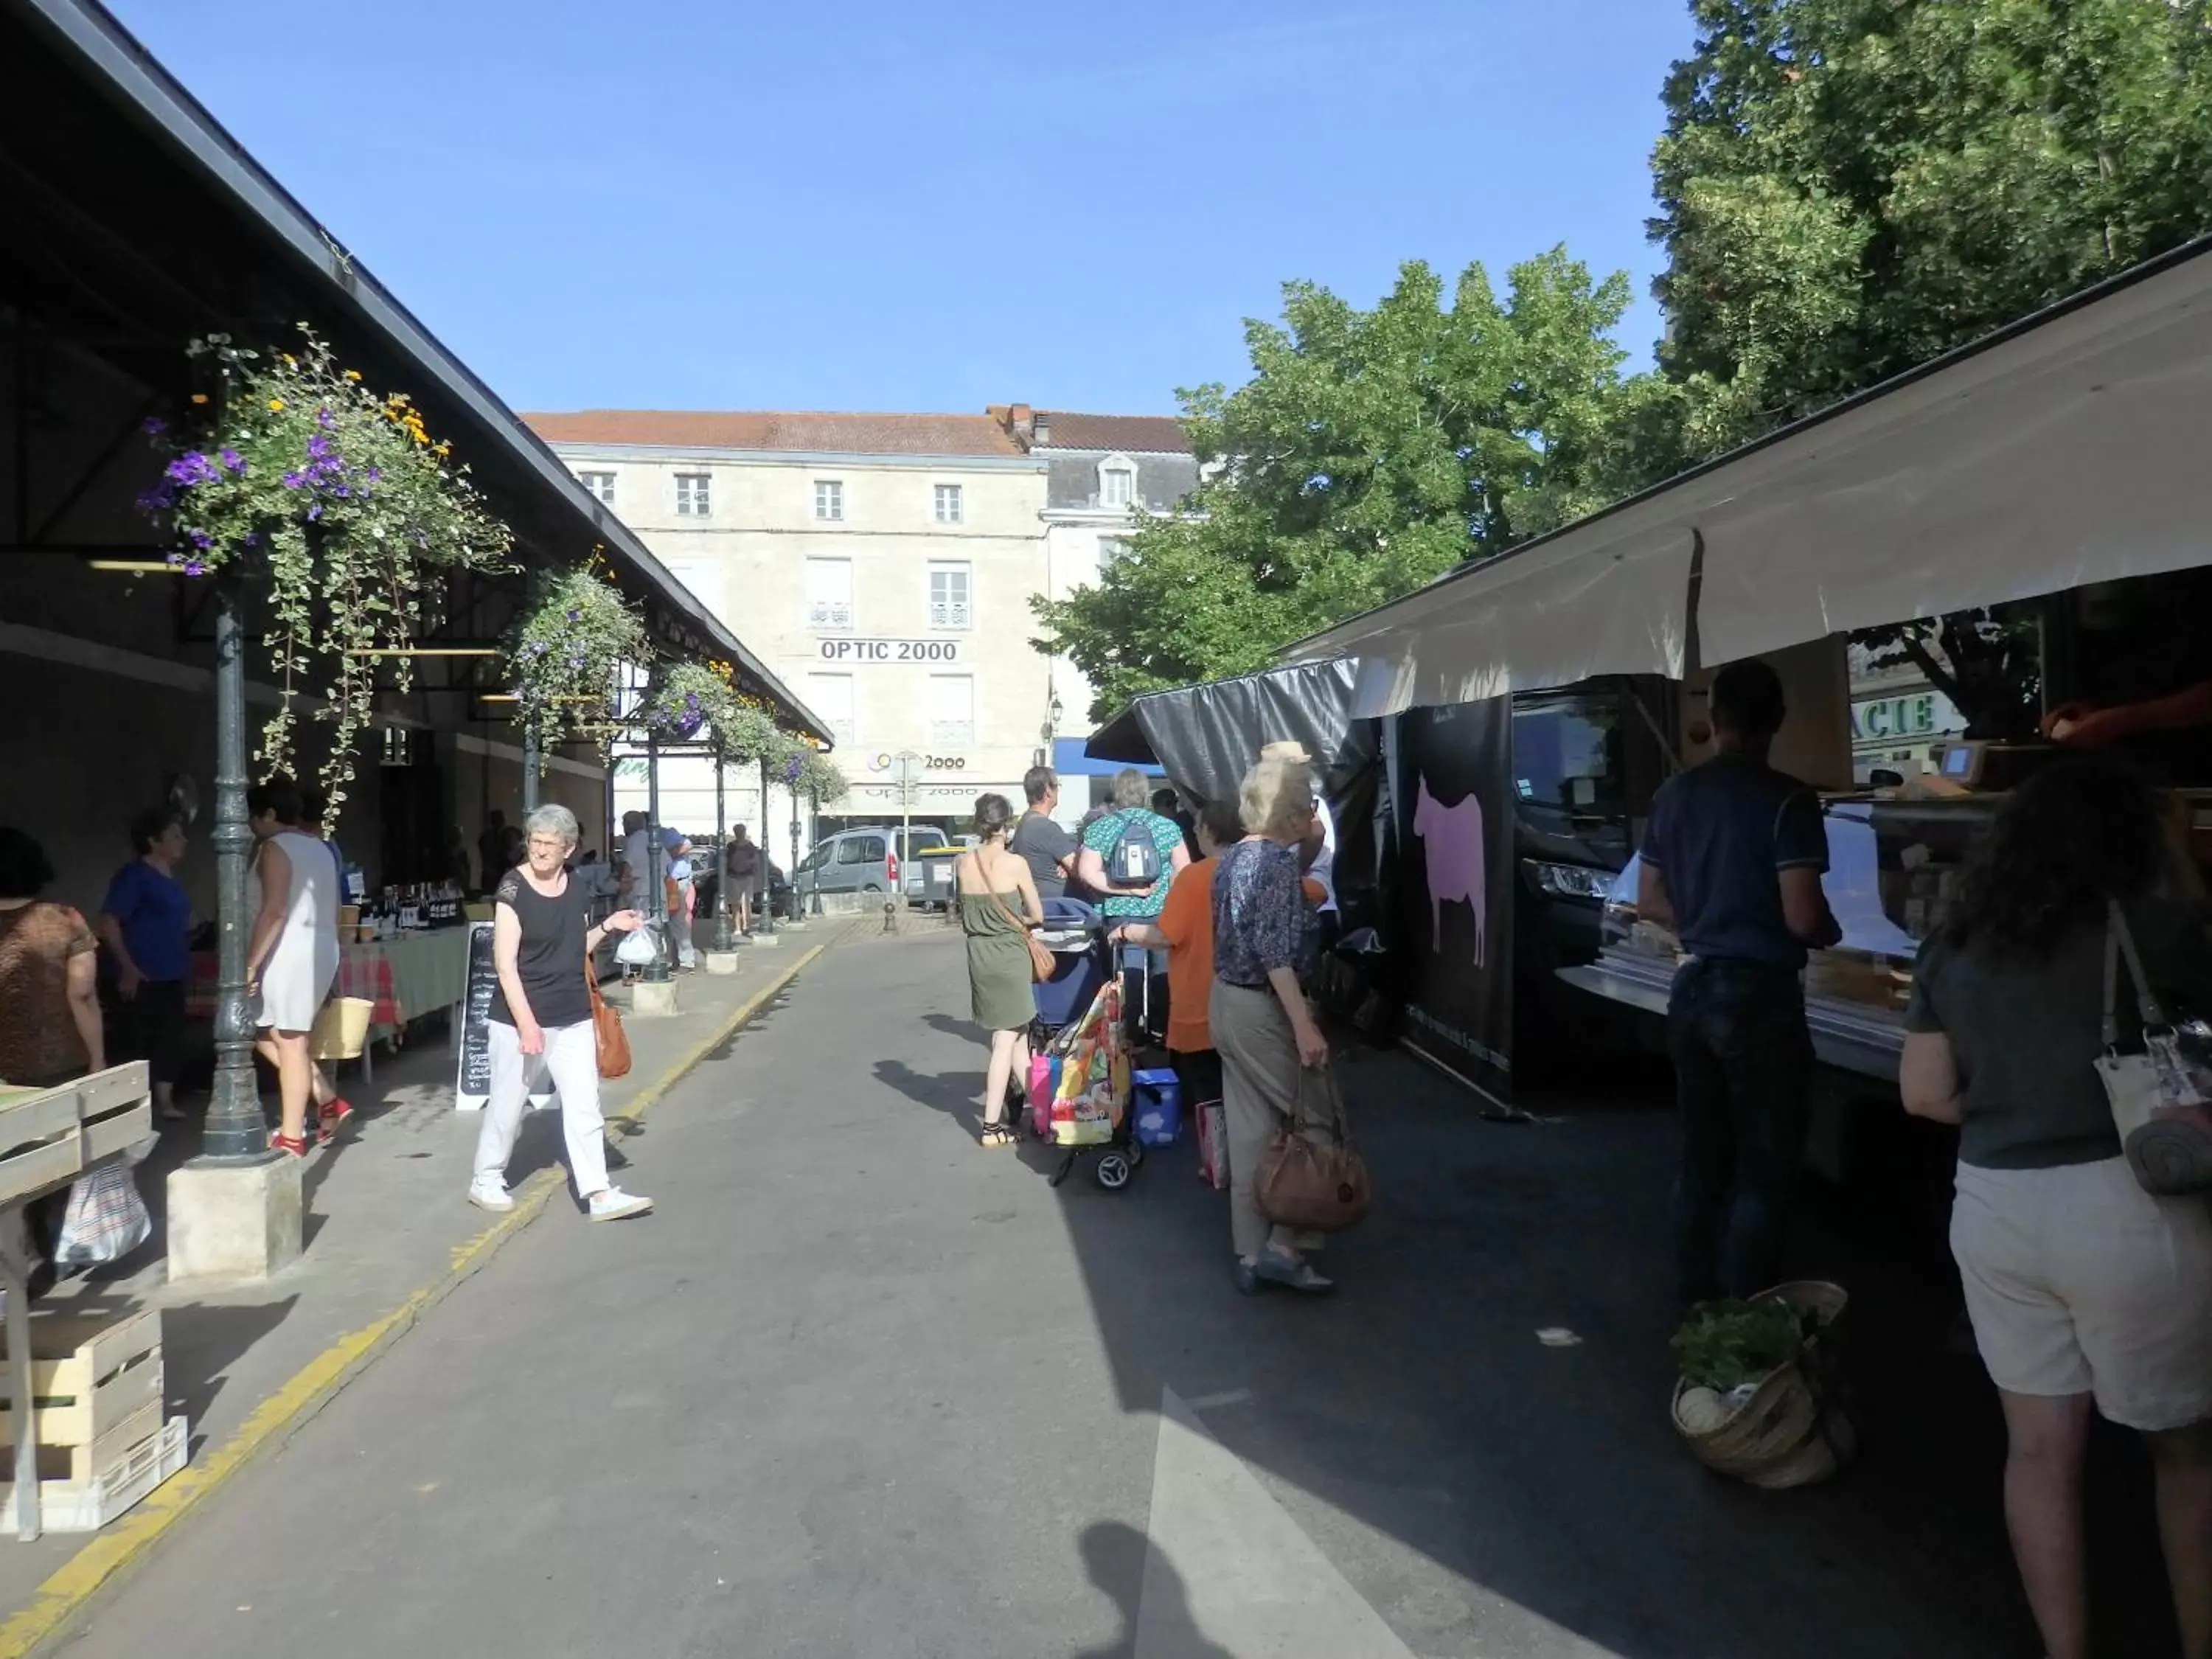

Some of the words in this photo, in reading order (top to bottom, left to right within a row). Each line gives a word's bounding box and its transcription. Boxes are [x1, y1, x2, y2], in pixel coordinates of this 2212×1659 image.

[821, 641, 888, 660] OPTIC
[897, 642, 956, 661] 2000
[925, 754, 965, 768] 2000
